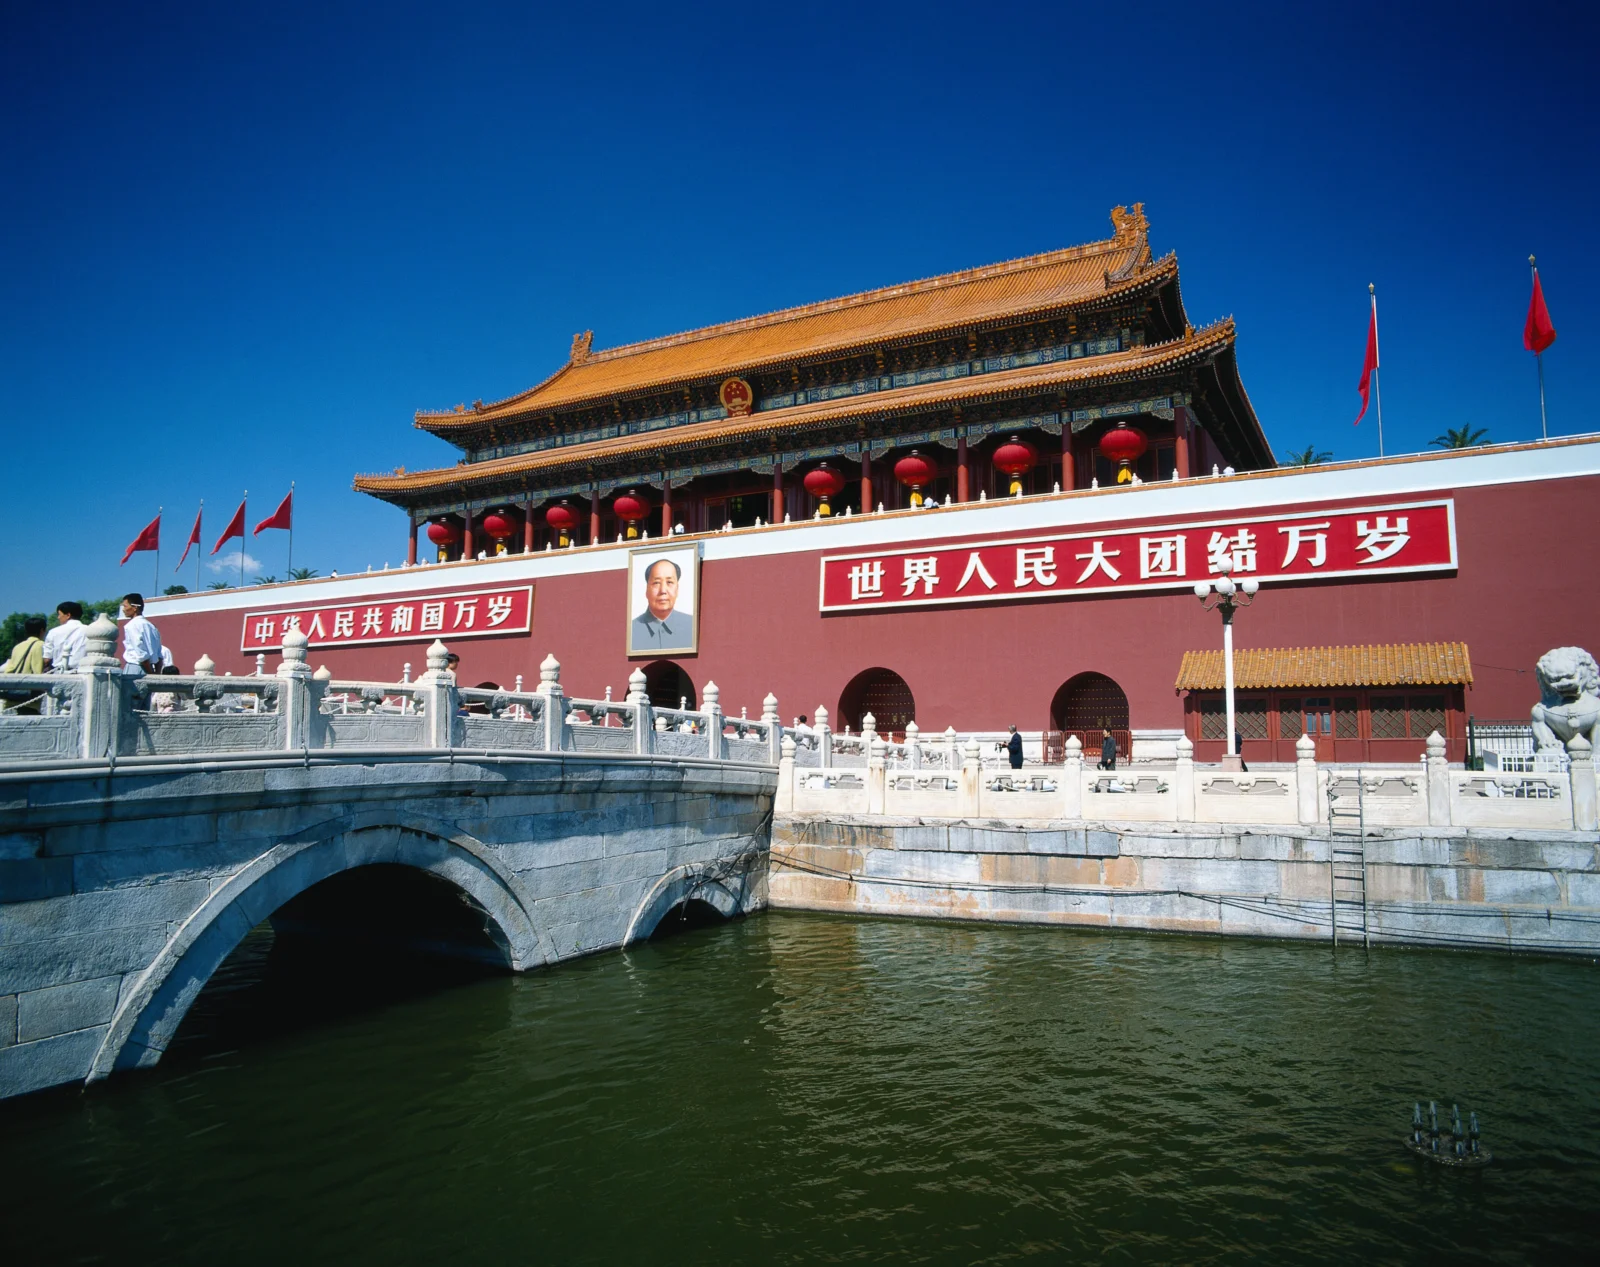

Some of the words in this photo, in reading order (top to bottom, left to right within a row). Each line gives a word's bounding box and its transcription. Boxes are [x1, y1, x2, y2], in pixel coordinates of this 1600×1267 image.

[847, 516, 1411, 600] 世界人民大团结万岁
